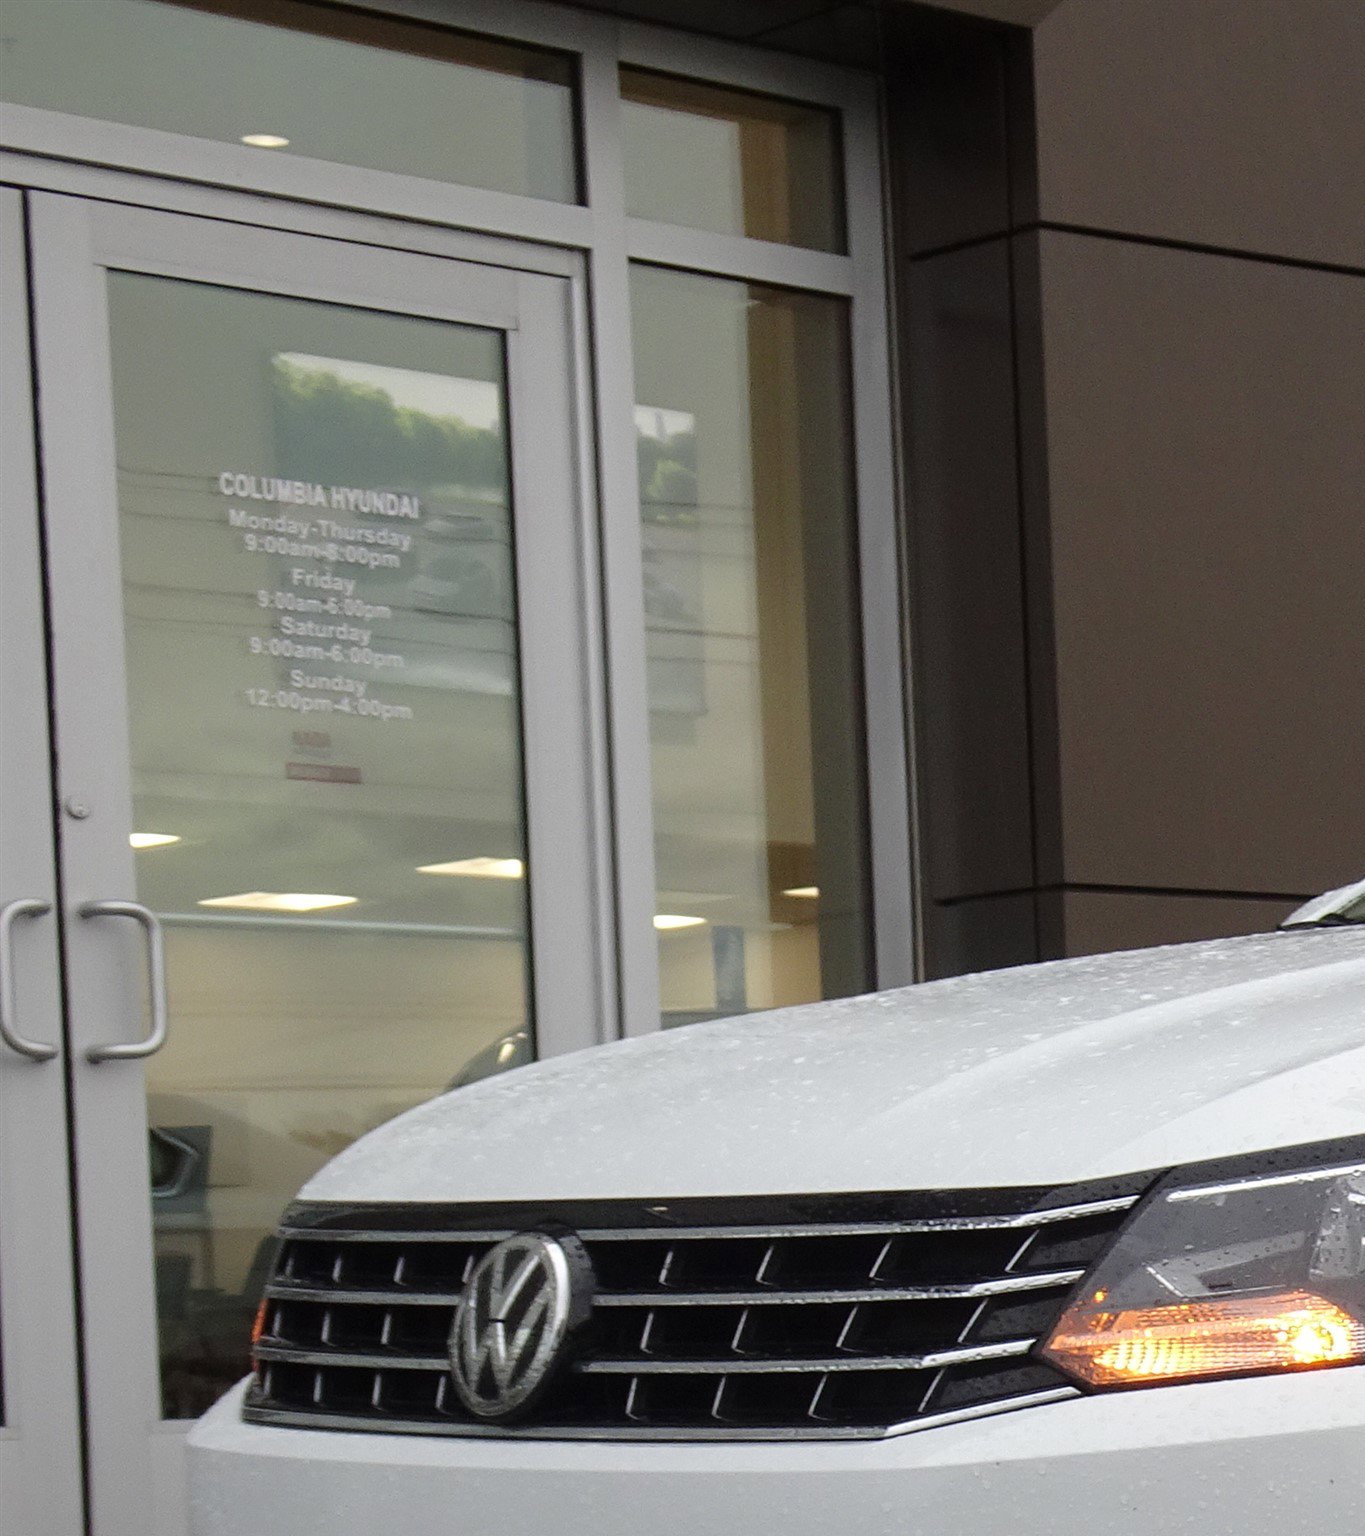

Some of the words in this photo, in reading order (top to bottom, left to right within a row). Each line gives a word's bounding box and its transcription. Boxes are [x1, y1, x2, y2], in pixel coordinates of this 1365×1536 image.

[219, 471, 327, 507] COLUMBIA
[331, 487, 420, 518] HYUNDAI
[228, 509, 412, 552] Monday-Thursday
[291, 568, 355, 596] Friday
[280, 616, 372, 646] Saturday
[290, 669, 366, 698] Sunday
[449, 1231, 571, 1416] VW
